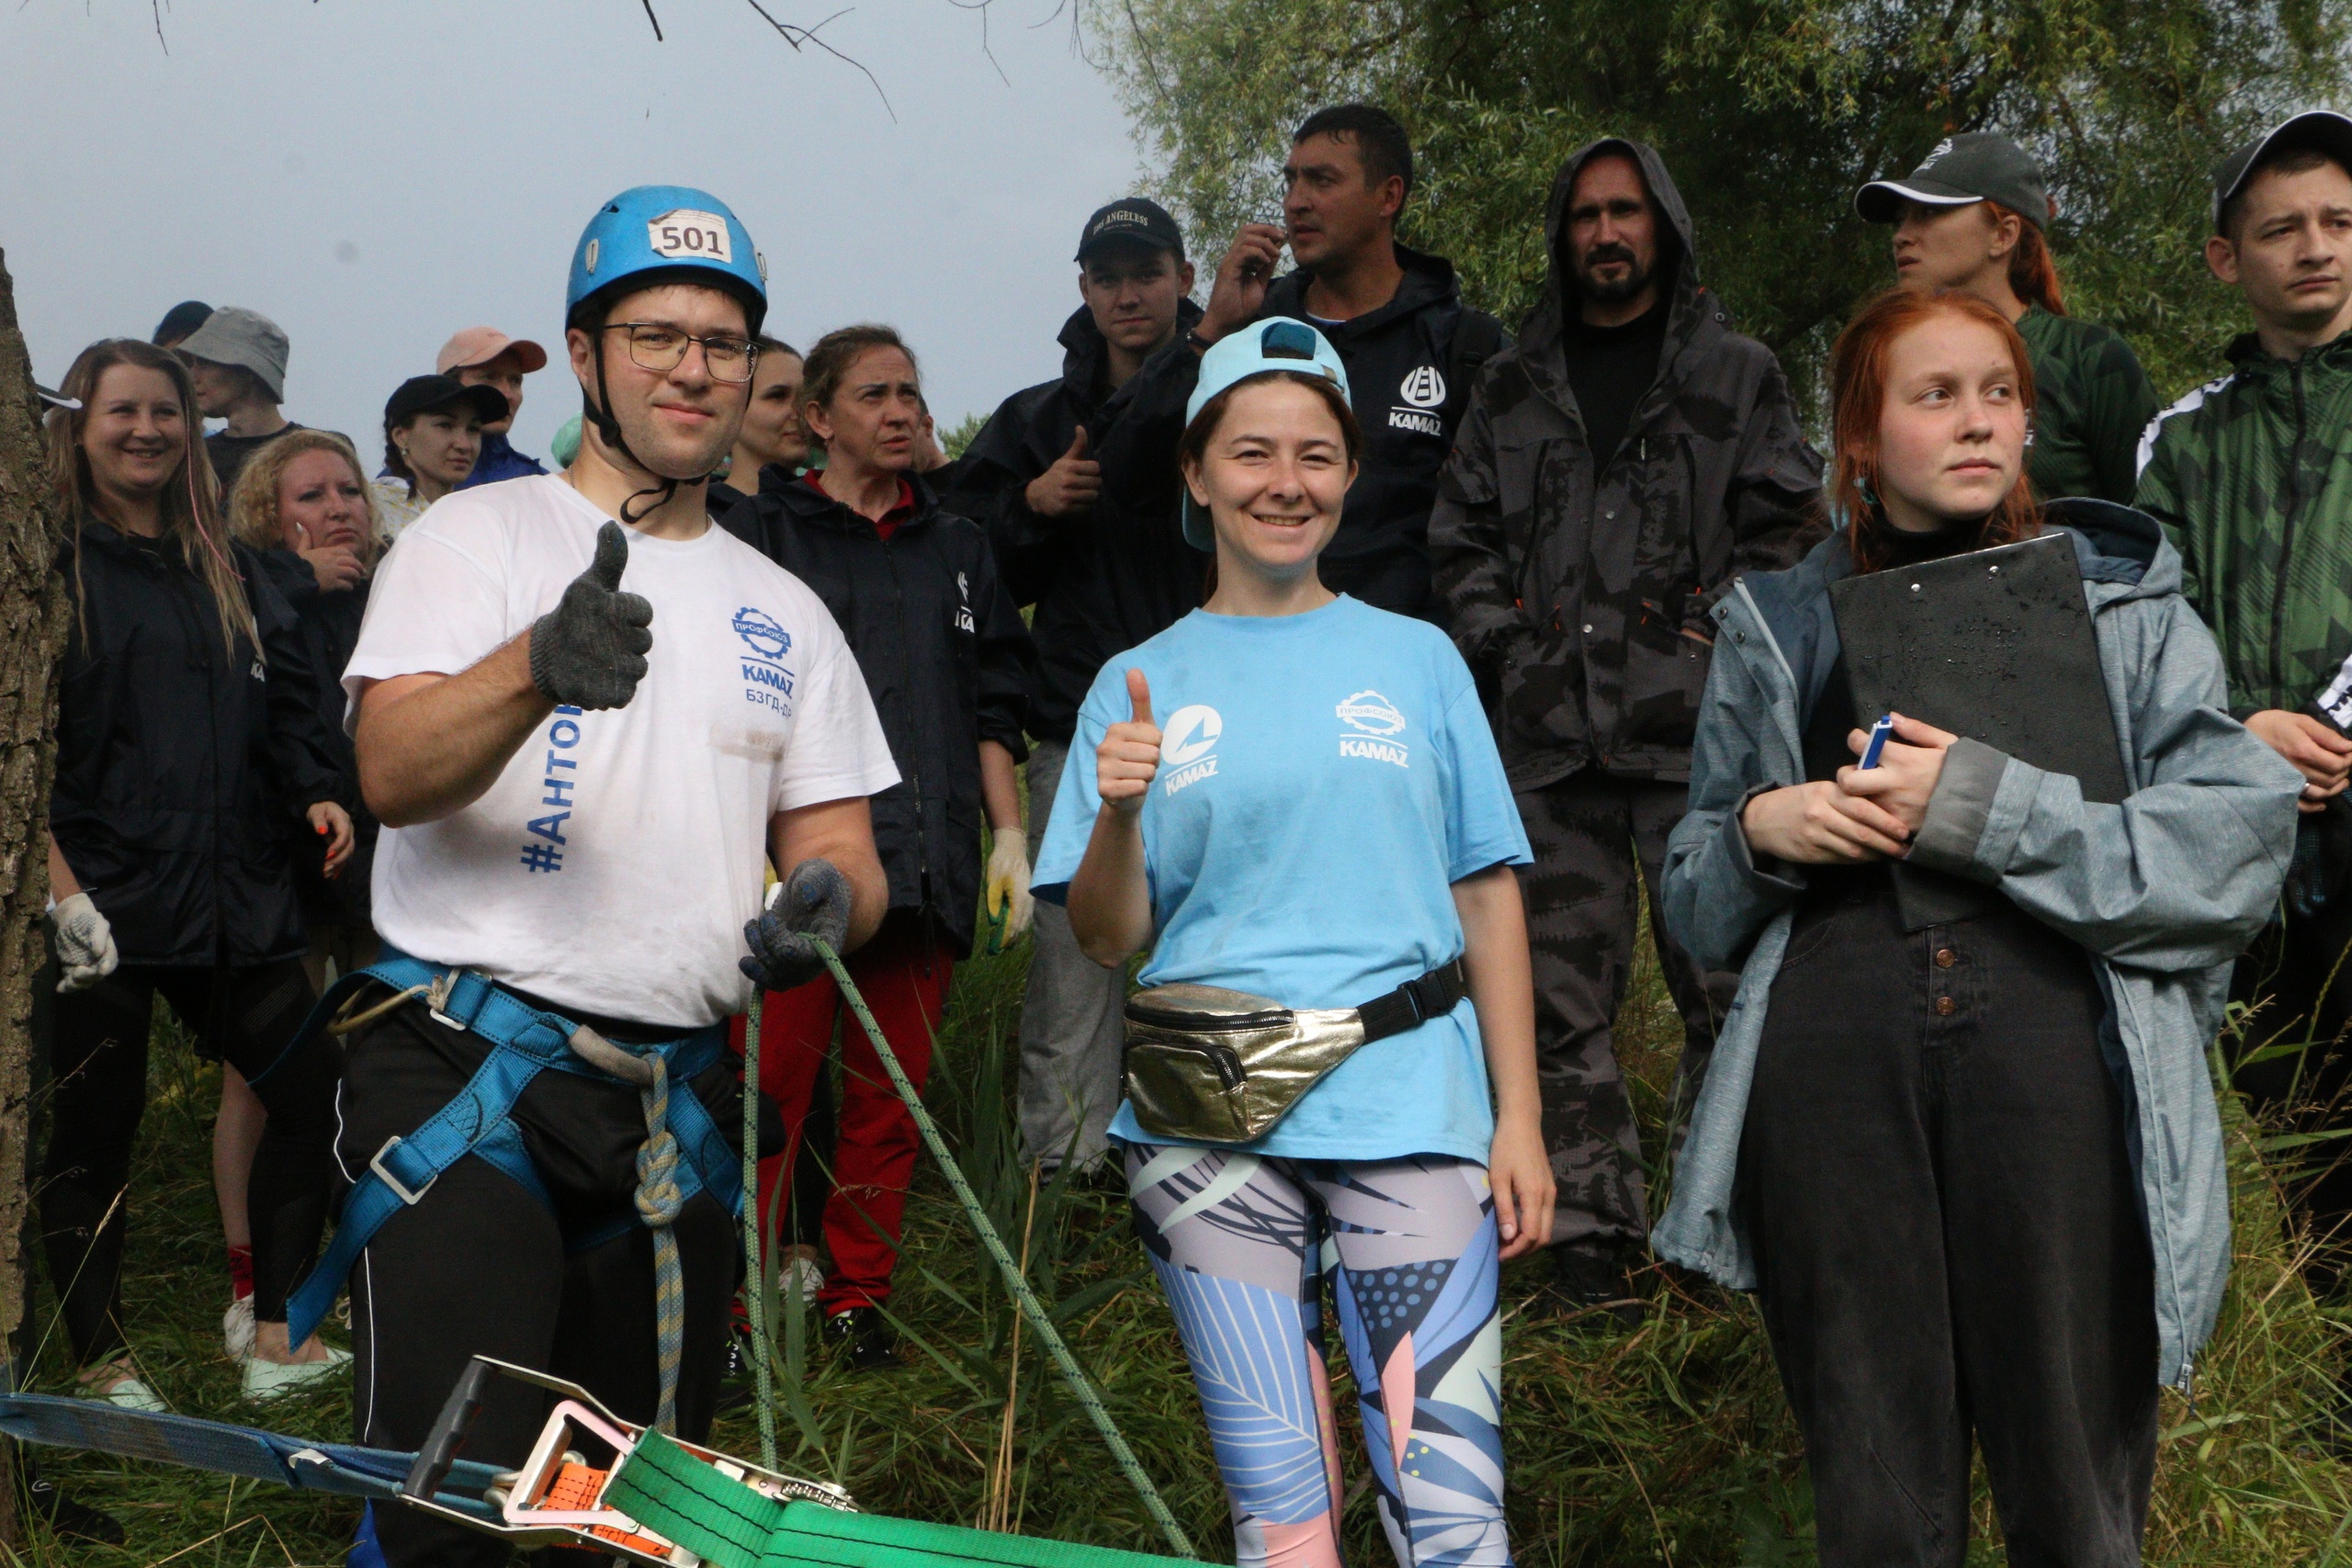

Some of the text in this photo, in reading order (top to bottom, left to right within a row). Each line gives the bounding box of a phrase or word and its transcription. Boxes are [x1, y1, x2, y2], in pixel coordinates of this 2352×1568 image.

[1105, 209, 1148, 227] ANGELESS
[662, 226, 724, 255] 501
[1388, 412, 1442, 436] KAMAZ
[735, 623, 789, 643] ПРОФСОЮЗ
[741, 663, 794, 700] KAMAZ
[1340, 707, 1403, 724] ПРОФСОЮЗ
[1340, 740, 1409, 768] KAMAZ
[1165, 760, 1219, 797] KAMAZ
